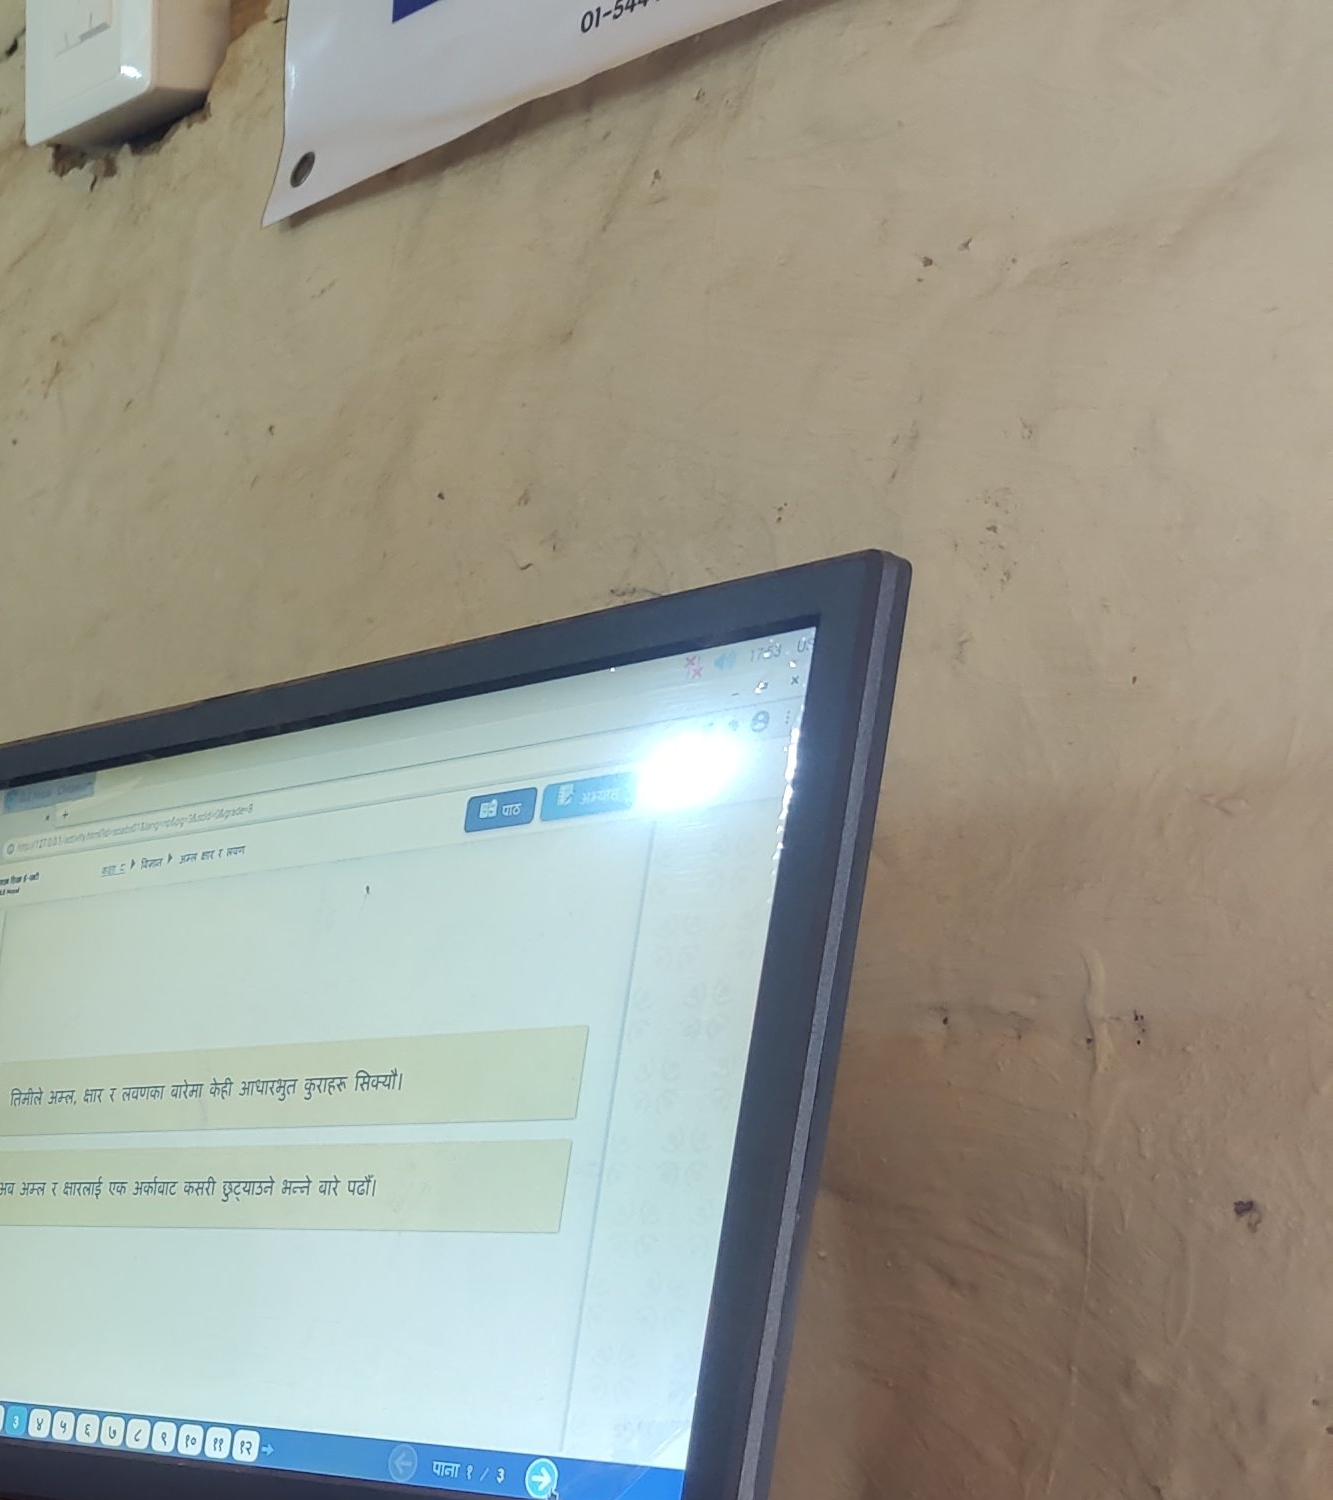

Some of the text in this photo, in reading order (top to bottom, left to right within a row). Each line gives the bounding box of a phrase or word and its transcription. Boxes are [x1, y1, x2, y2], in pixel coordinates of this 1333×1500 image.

[750, 642, 782, 662] 1753
[502, 801, 523, 818] पाठ
[10, 1087, 43, 1107] तिमीले
[47, 1089, 77, 1106] अम्ल,
[83, 1088, 104, 1104] क्षार
[109, 1087, 117, 1103] र
[122, 1085, 166, 1101] लवणका
[209, 1077, 234, 1100] केही
[19, 1181, 46, 1197] अम्ल
[51, 1182, 58, 1197] र
[62, 1176, 104, 1200] क्षारलाई
[108, 1181, 128, 1197] एक
[183, 1176, 217, 1197] कसरी
[221, 1175, 276, 1203] छुट्याउने
[281, 1175, 313, 1197] भन्ने
[12, 1417, 20, 1430] ३
[36, 1417, 44, 1431] ४
[60, 1421, 67, 1434] ५
[84, 1424, 91, 1438] ६
[108, 1427, 117, 1440] ७
[134, 1430, 142, 1442] ८
[161, 1432, 168, 1446] ९
[184, 1434, 197, 1449] १०
[212, 1437, 224, 1451] ११
[239, 1439, 253, 1456] १२
[432, 1460, 460, 1478] पाना
[466, 1464, 474, 1480] १
[496, 1468, 505, 1484] ३
